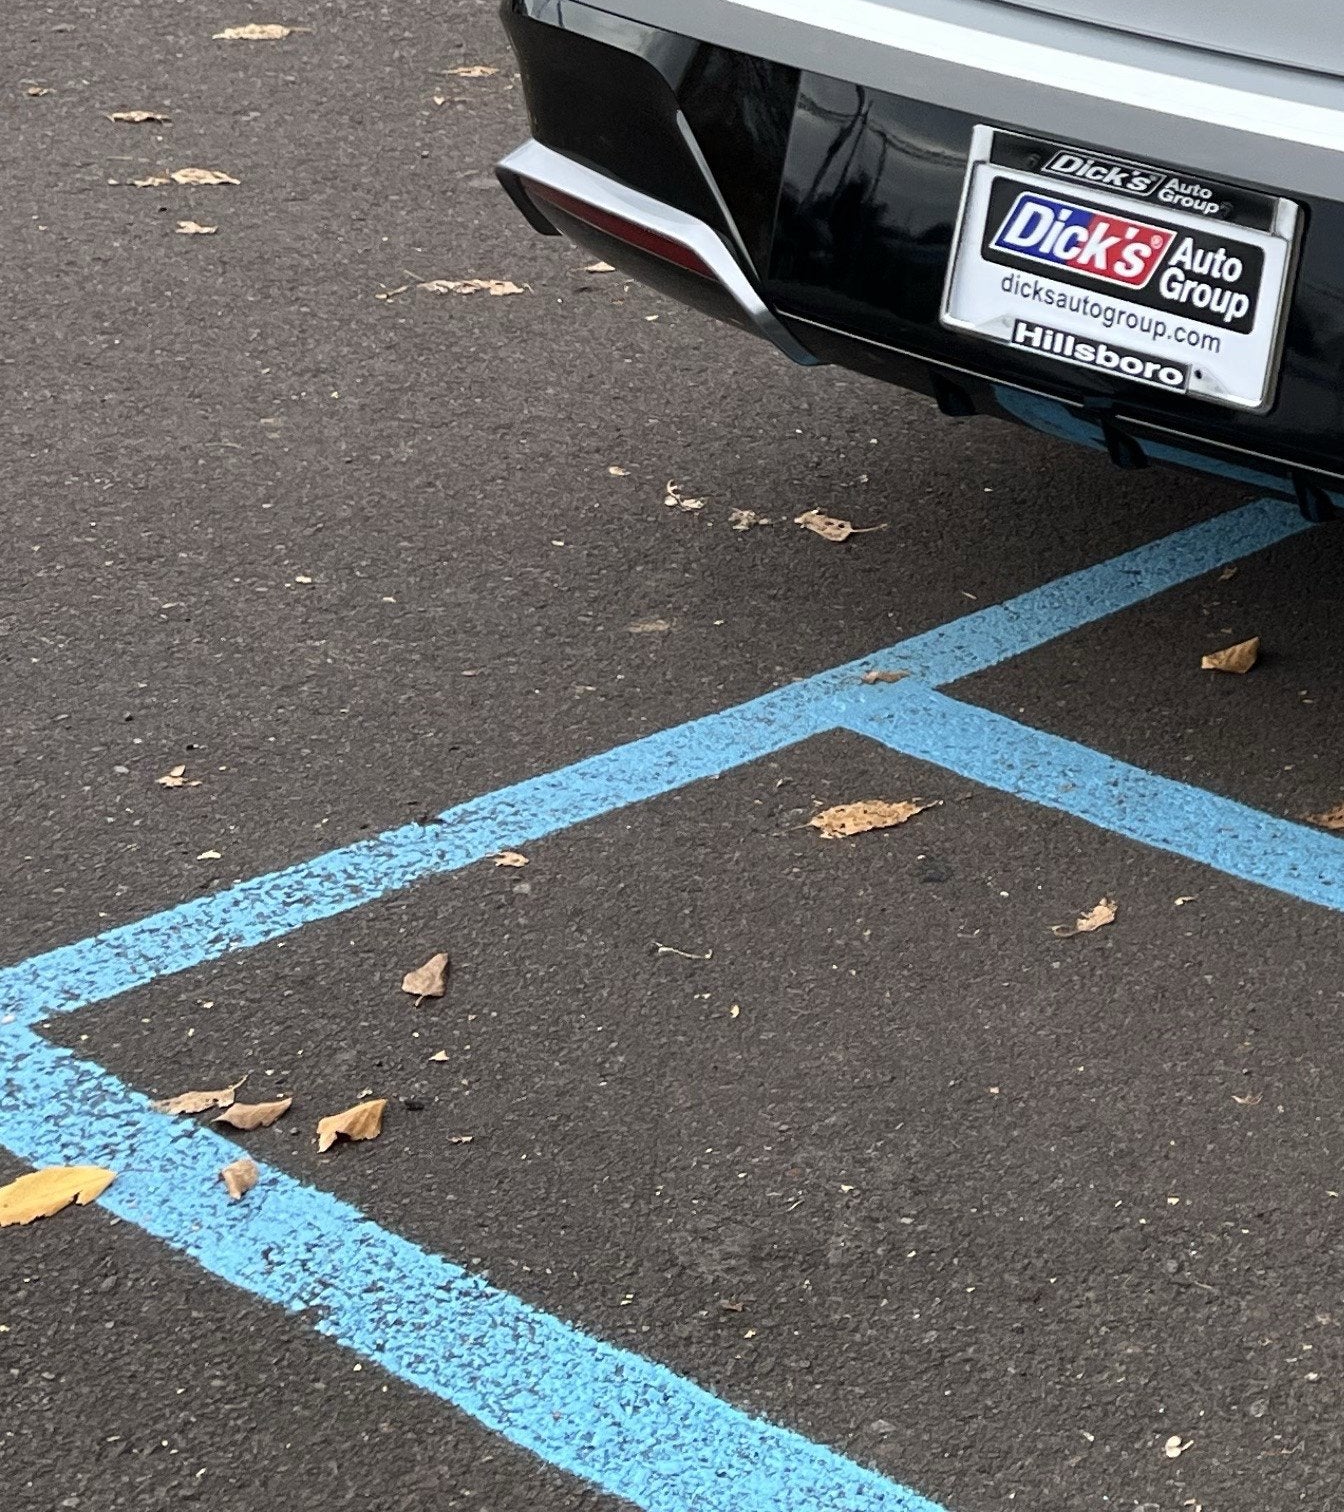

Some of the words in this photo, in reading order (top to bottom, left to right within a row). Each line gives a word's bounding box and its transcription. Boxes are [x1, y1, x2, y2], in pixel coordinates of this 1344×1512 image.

[1051, 154, 1151, 191] Dick's
[1165, 178, 1213, 200] Auto
[1157, 188, 1220, 215] Group
[1003, 201, 1152, 278] Dick's
[1168, 237, 1243, 283] Auto
[1001, 273, 1221, 353] dicksautogroup.com
[1160, 267, 1250, 323] Group
[1015, 322, 1184, 386] Hillsboro
